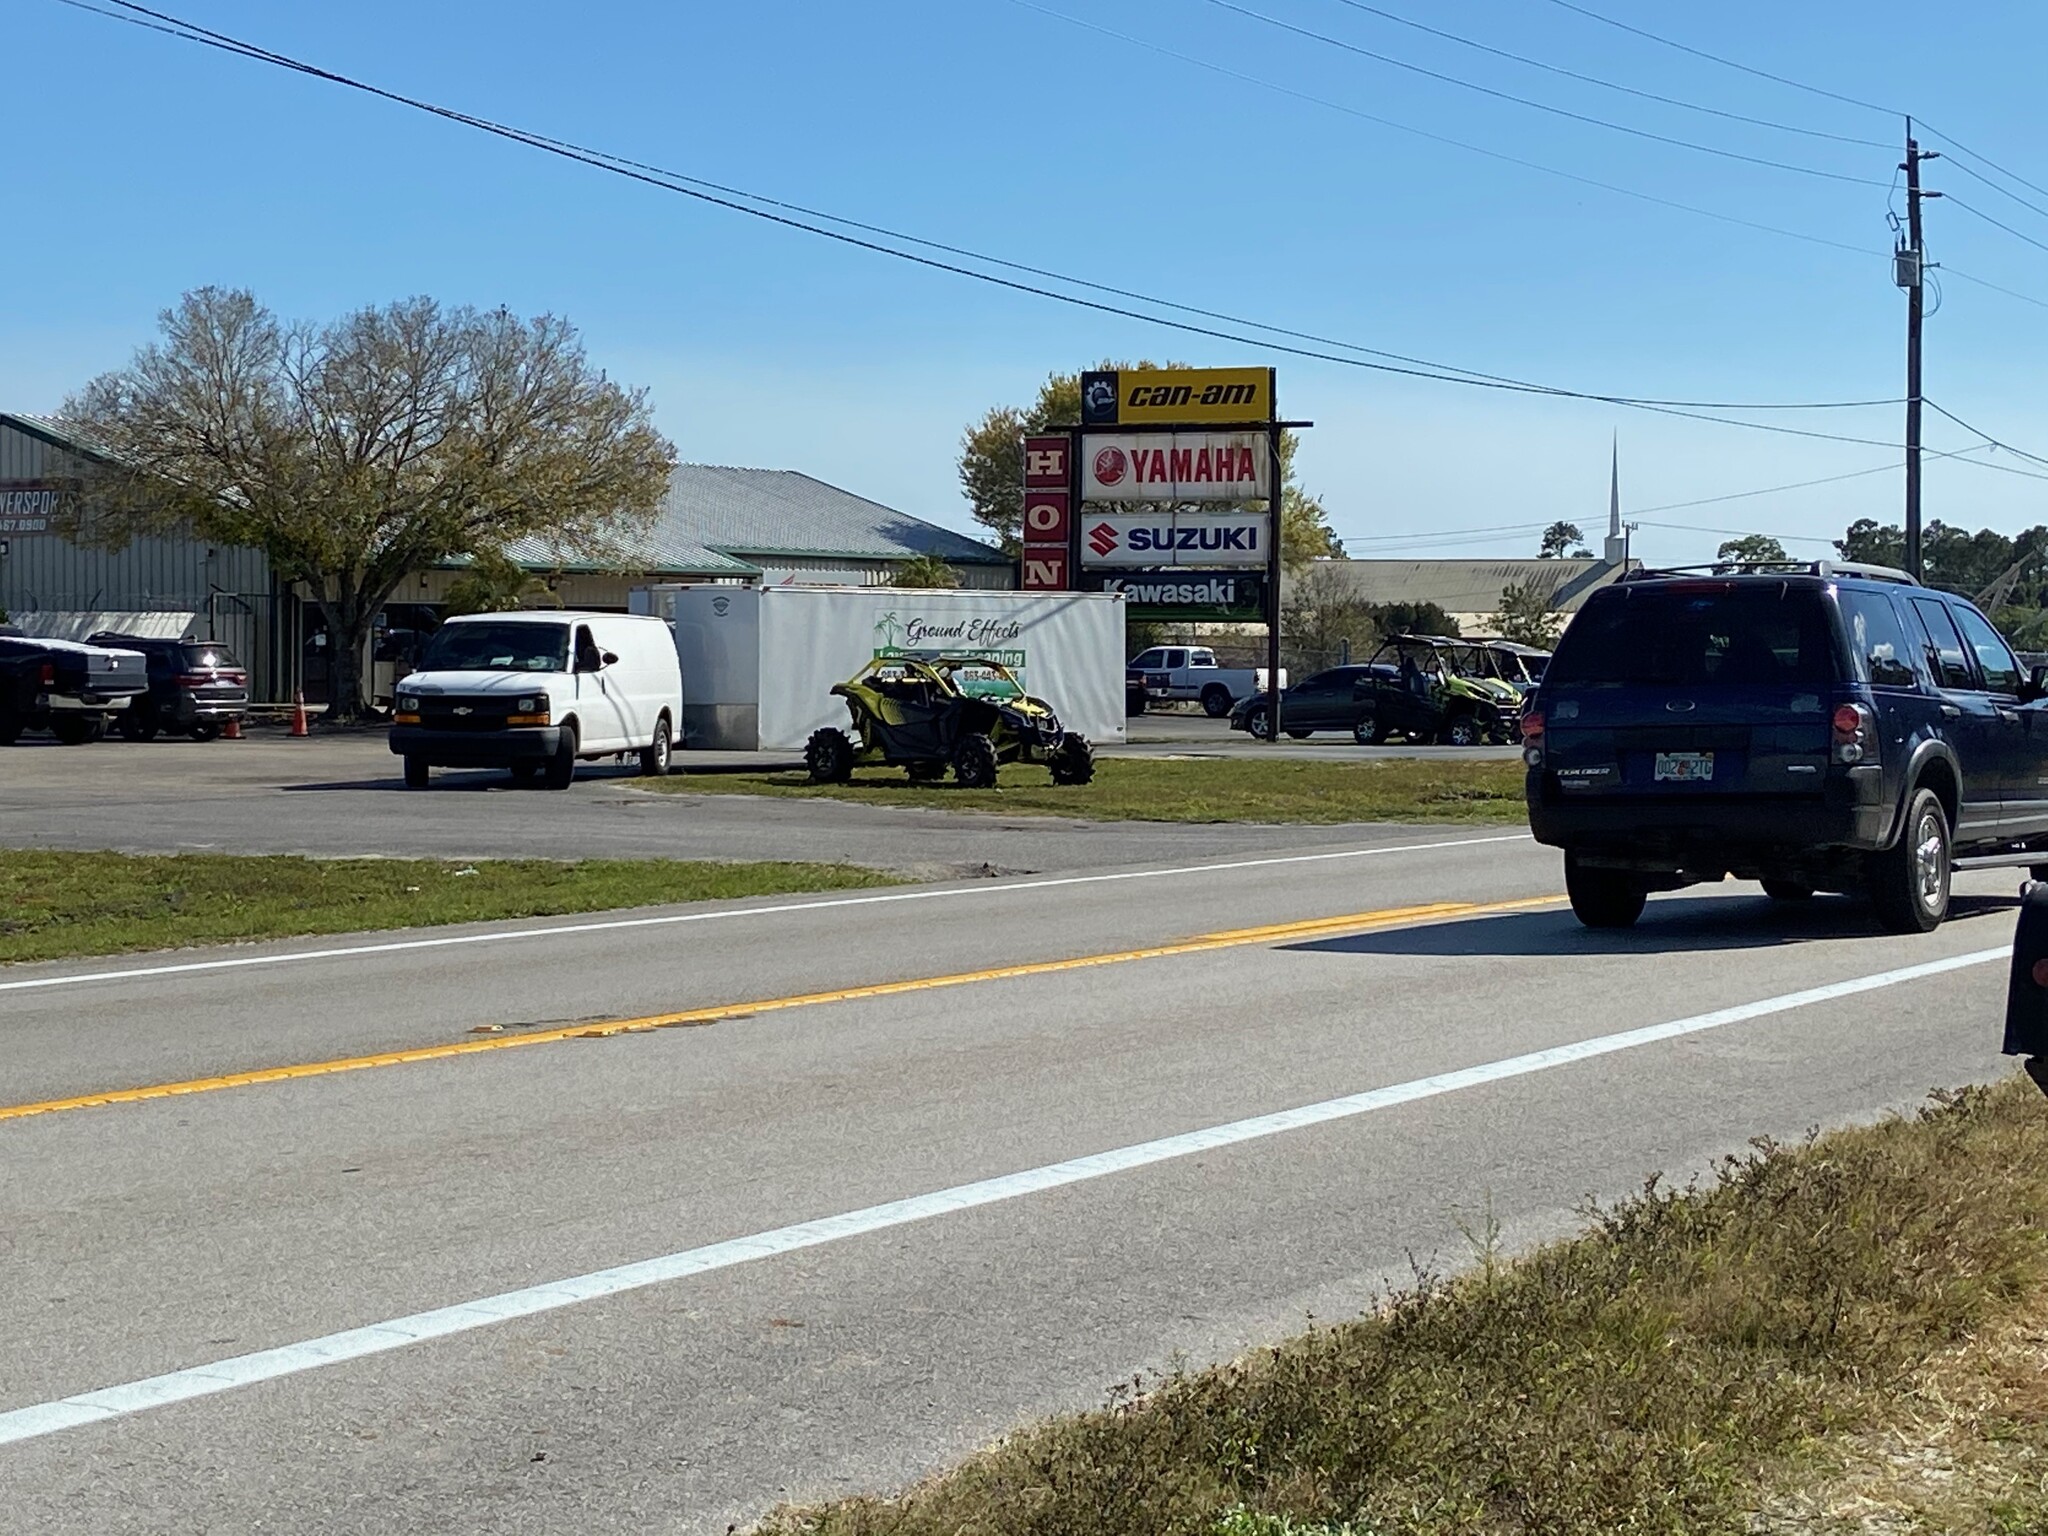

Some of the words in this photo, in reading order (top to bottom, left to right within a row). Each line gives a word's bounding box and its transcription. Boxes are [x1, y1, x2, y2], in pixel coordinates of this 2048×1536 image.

[1127, 382, 1258, 408] can-am
[1129, 447, 1257, 483] YAMAHA
[1127, 526, 1258, 551] SUZUKI
[1103, 578, 1236, 603] Kawasaki
[905, 617, 966, 647] Ground
[967, 618, 1024, 647] Effects
